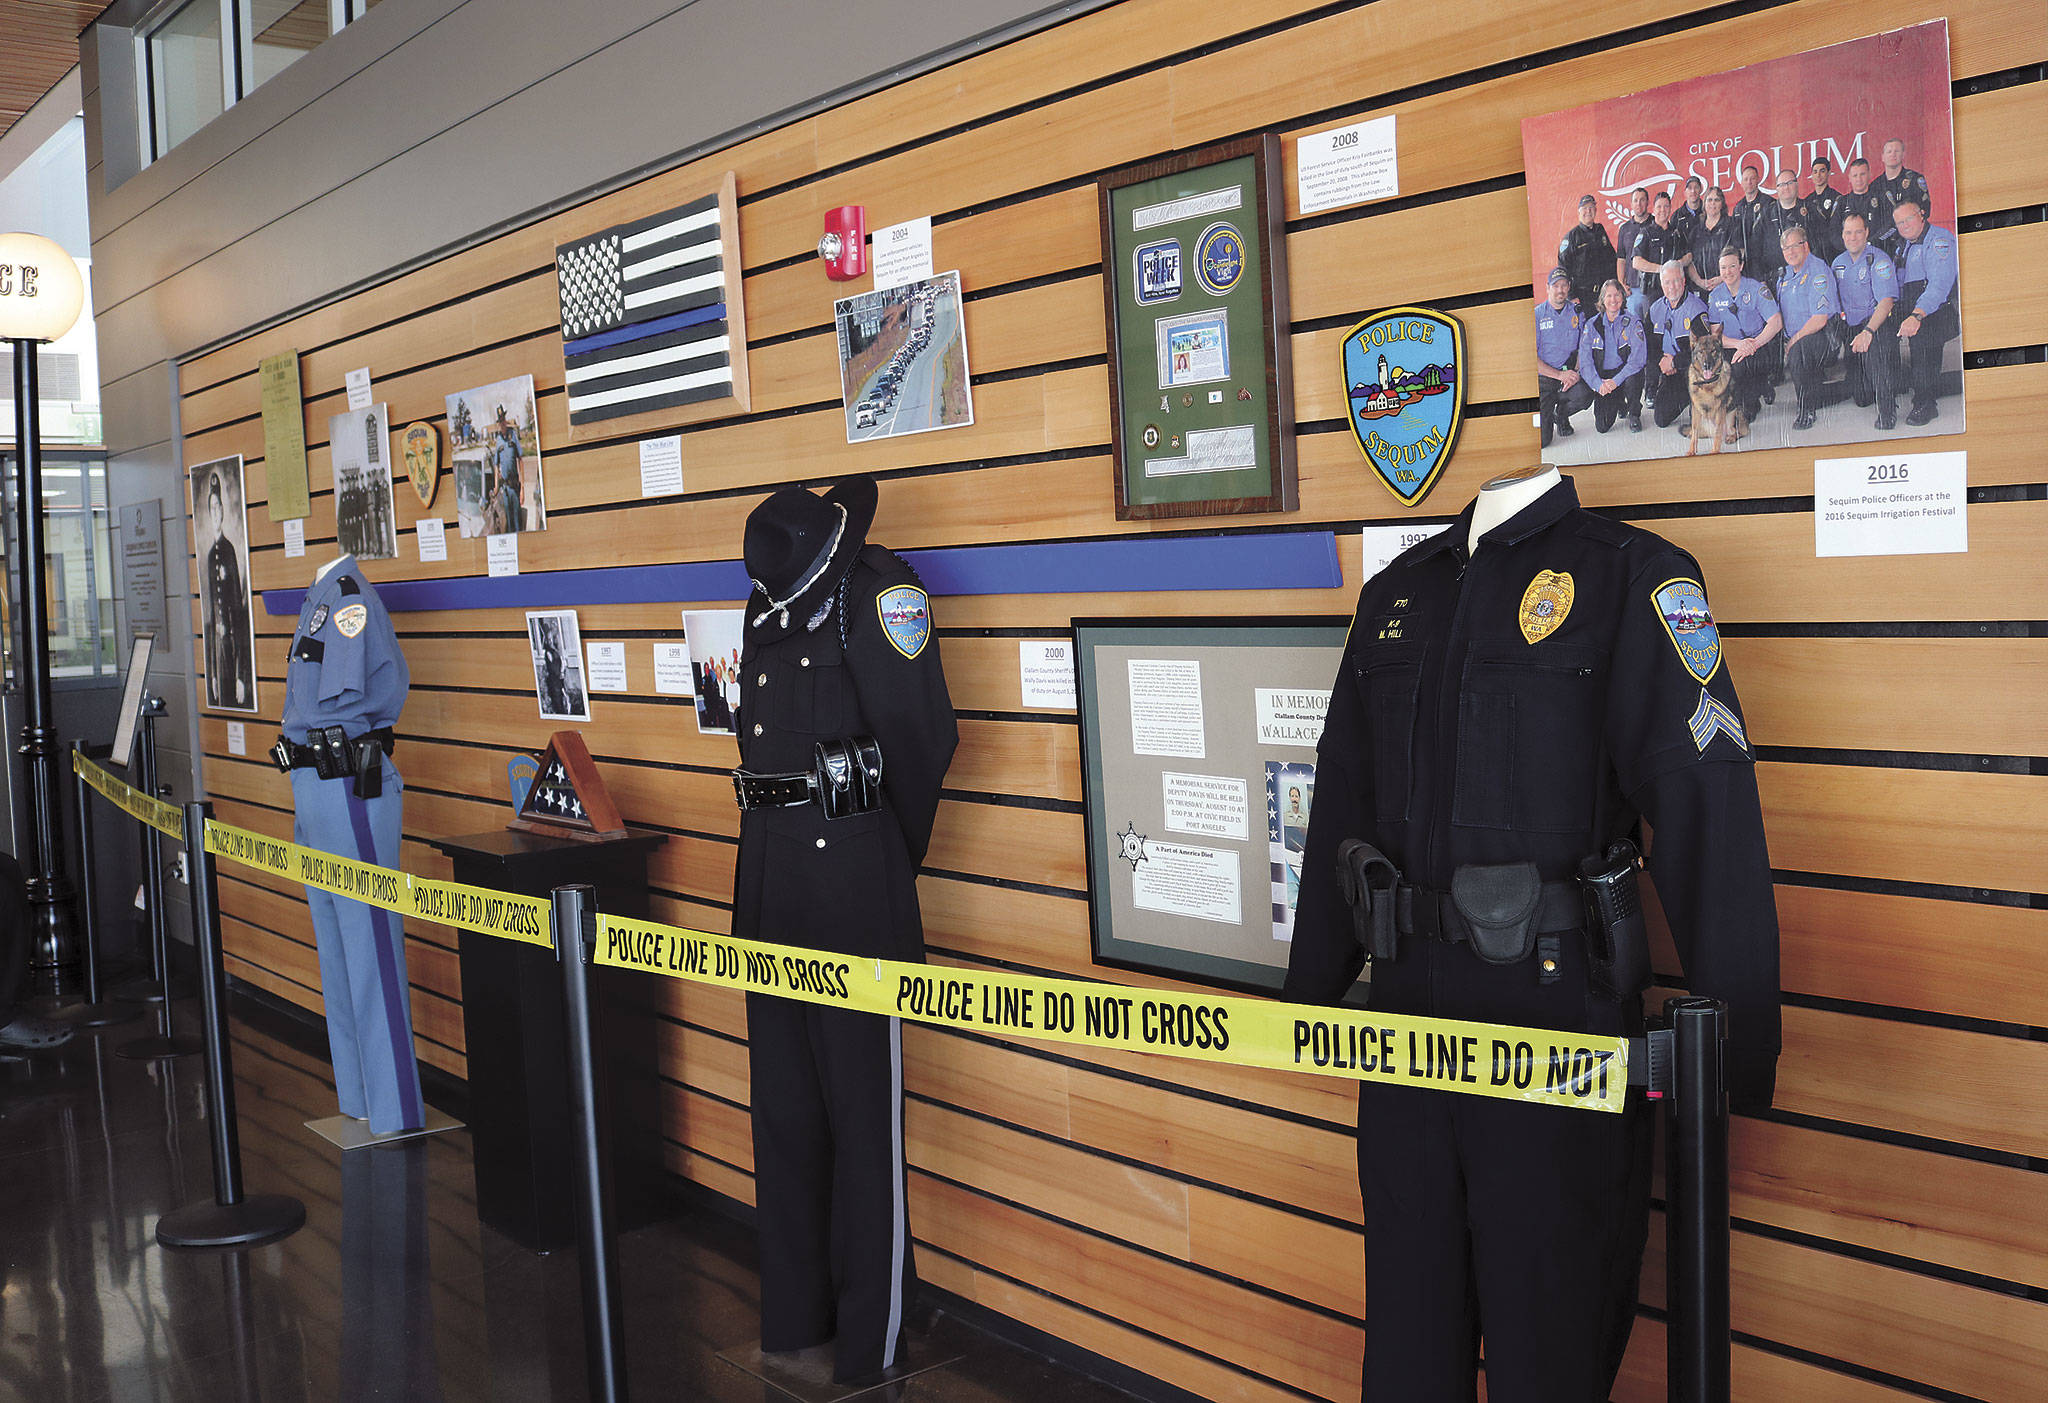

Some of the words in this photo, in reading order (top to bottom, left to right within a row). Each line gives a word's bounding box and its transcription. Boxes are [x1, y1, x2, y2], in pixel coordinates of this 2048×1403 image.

[1332, 131, 1358, 148] 2008
[1690, 140, 1718, 155] CITY
[1724, 136, 1742, 148] OF
[1369, 158, 1386, 166] Sequim
[1688, 131, 1866, 195] SEQUIM
[1306, 180, 1329, 190] September
[1358, 188, 1386, 197] Washington
[892, 228, 908, 240] 2004
[1144, 255, 1178, 274] POLICE
[1146, 269, 1175, 285] WEEK
[1358, 321, 1435, 354] POLICE
[1365, 426, 1444, 468] SEQUIM
[1396, 470, 1420, 482] WA.
[1868, 464, 1908, 480] 2016
[1829, 497, 1860, 506] Sequim
[1862, 495, 1886, 504] Police
[1889, 493, 1922, 503] Officers
[1936, 492, 1950, 500] the
[1825, 512, 1845, 520] 2016
[1847, 511, 1878, 520] Sequim
[1880, 508, 1920, 520] Irrigation
[1922, 507, 1956, 516] Festival
[888, 591, 920, 600] POLICE
[1666, 584, 1704, 600] POLICE
[892, 628, 926, 644] SEQUIM
[1045, 648, 1064, 658] 2000
[1681, 640, 1718, 662] SEQUIM
[1272, 695, 1283, 708] IN
[1262, 724, 1318, 740] WALLACE
[1176, 780, 1204, 788] MEMORIAL
[1204, 782, 1227, 790] SERVICE
[1206, 803, 1226, 812] AUGUST
[1201, 824, 1226, 832] ANGELES
[212, 828, 230, 853] POLICE
[231, 834, 244, 858] LINE
[246, 838, 254, 860] DO
[254, 840, 266, 864] NOT
[267, 844, 288, 870] CROSS
[1180, 849, 1200, 857] America
[301, 855, 324, 884] POLICE
[326, 860, 342, 888] LINE
[344, 866, 354, 890] DO
[356, 868, 370, 896] NOT
[372, 873, 398, 904] CROSS
[414, 886, 444, 917] POLICE
[446, 892, 466, 921] LINE
[470, 896, 482, 924] DO
[483, 899, 502, 929] NOT
[503, 902, 540, 936] CROSS
[608, 927, 664, 967] POLICE
[669, 936, 708, 974] LINE
[715, 944, 740, 980] DO
[743, 950, 780, 986] NOT
[782, 956, 850, 999] CROSS
[897, 975, 974, 1022] POLICE
[982, 984, 1034, 1029] LINE
[1044, 992, 1074, 1032] DO
[1086, 996, 1133, 1040] NOT
[1142, 1001, 1230, 1051] CROSS
[1294, 1020, 1396, 1074] POLICE
[1409, 1031, 1477, 1083] LINE
[1490, 1040, 1534, 1090] DO
[1546, 1046, 1616, 1100] NOT
